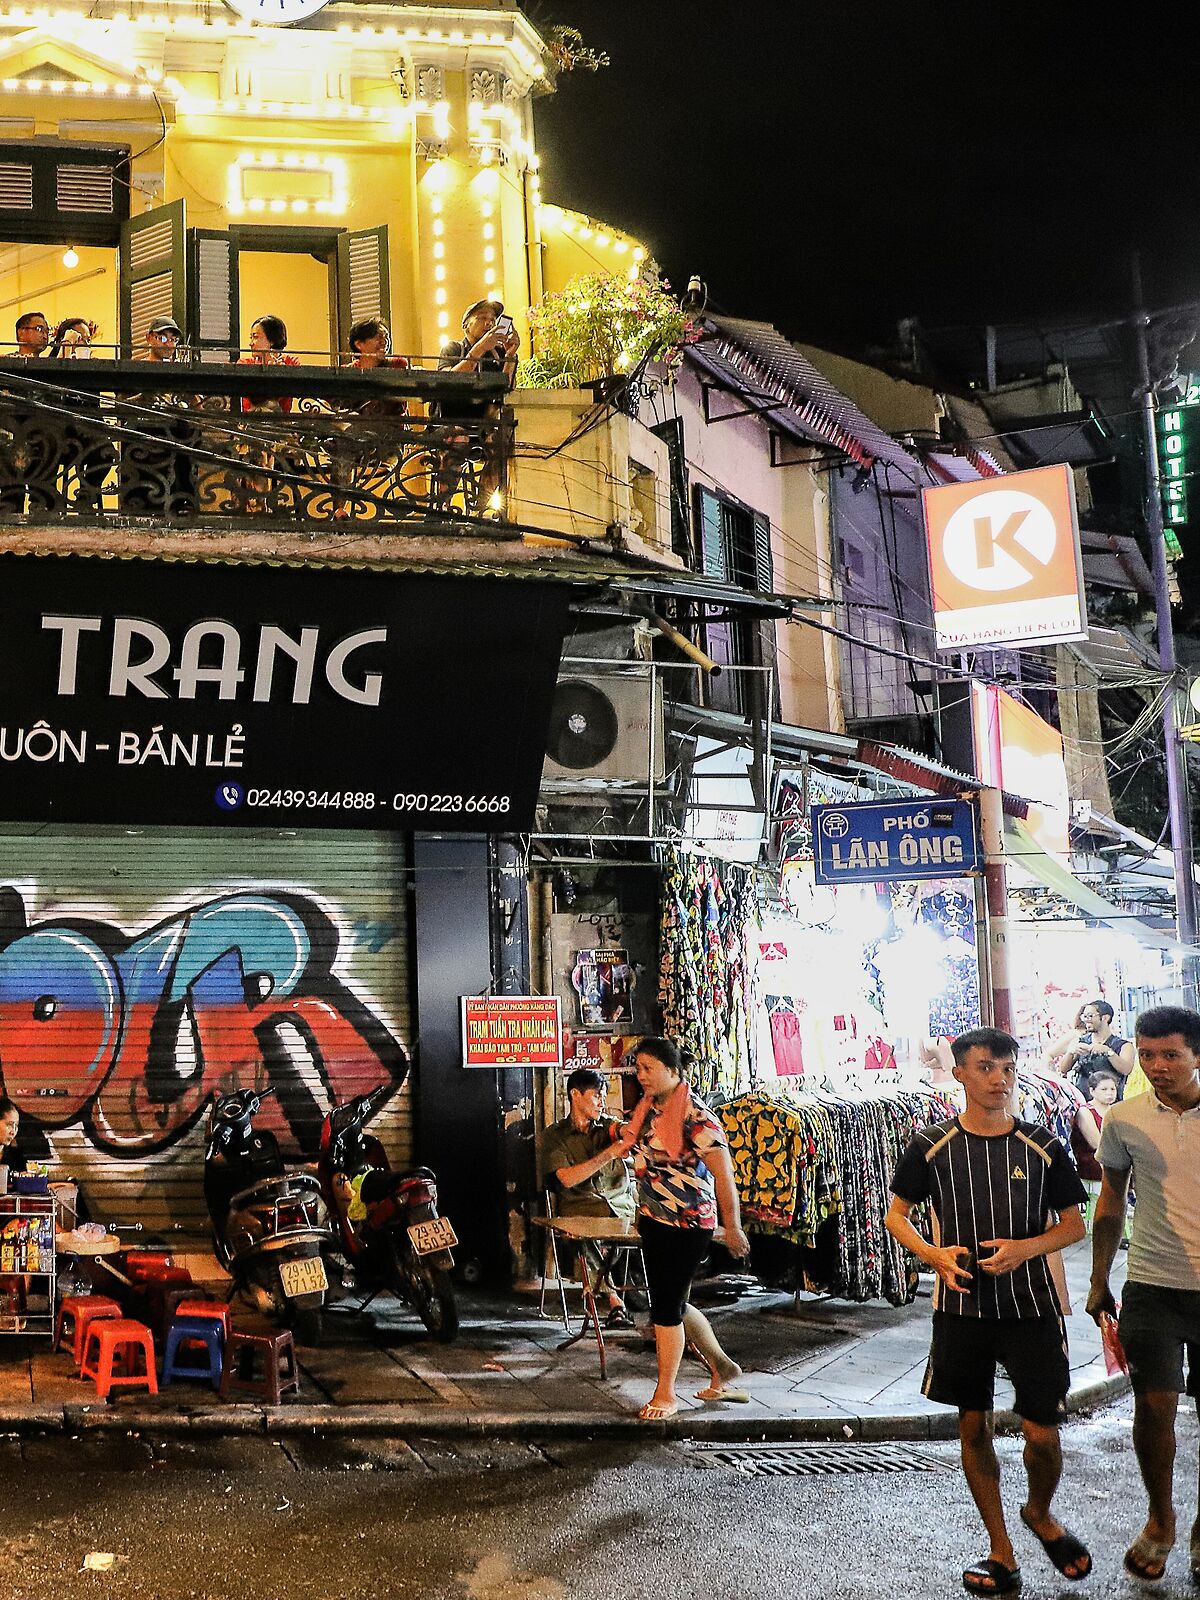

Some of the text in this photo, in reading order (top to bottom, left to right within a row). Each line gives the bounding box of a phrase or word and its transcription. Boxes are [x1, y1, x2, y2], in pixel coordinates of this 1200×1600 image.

[1163, 411, 1185, 524] HOTEL
[972, 508, 1052, 582] K
[40, 612, 388, 706] TRANG
[117, 724, 198, 767] BÁN
[204, 723, 246, 768] LẺ
[246, 788, 376, 810] 02439344888
[883, 808, 930, 832] PHỐ
[831, 833, 964, 871] LÃN ÔNG
[469, 1020, 489, 1042] TRẠM
[508, 1020, 521, 1038] TRA
[522, 1016, 541, 1038] NHÂN
[541, 1016, 556, 1039] DÂN
[469, 1043, 484, 1053] KHAI
[484, 1041, 497, 1053] BÁO
